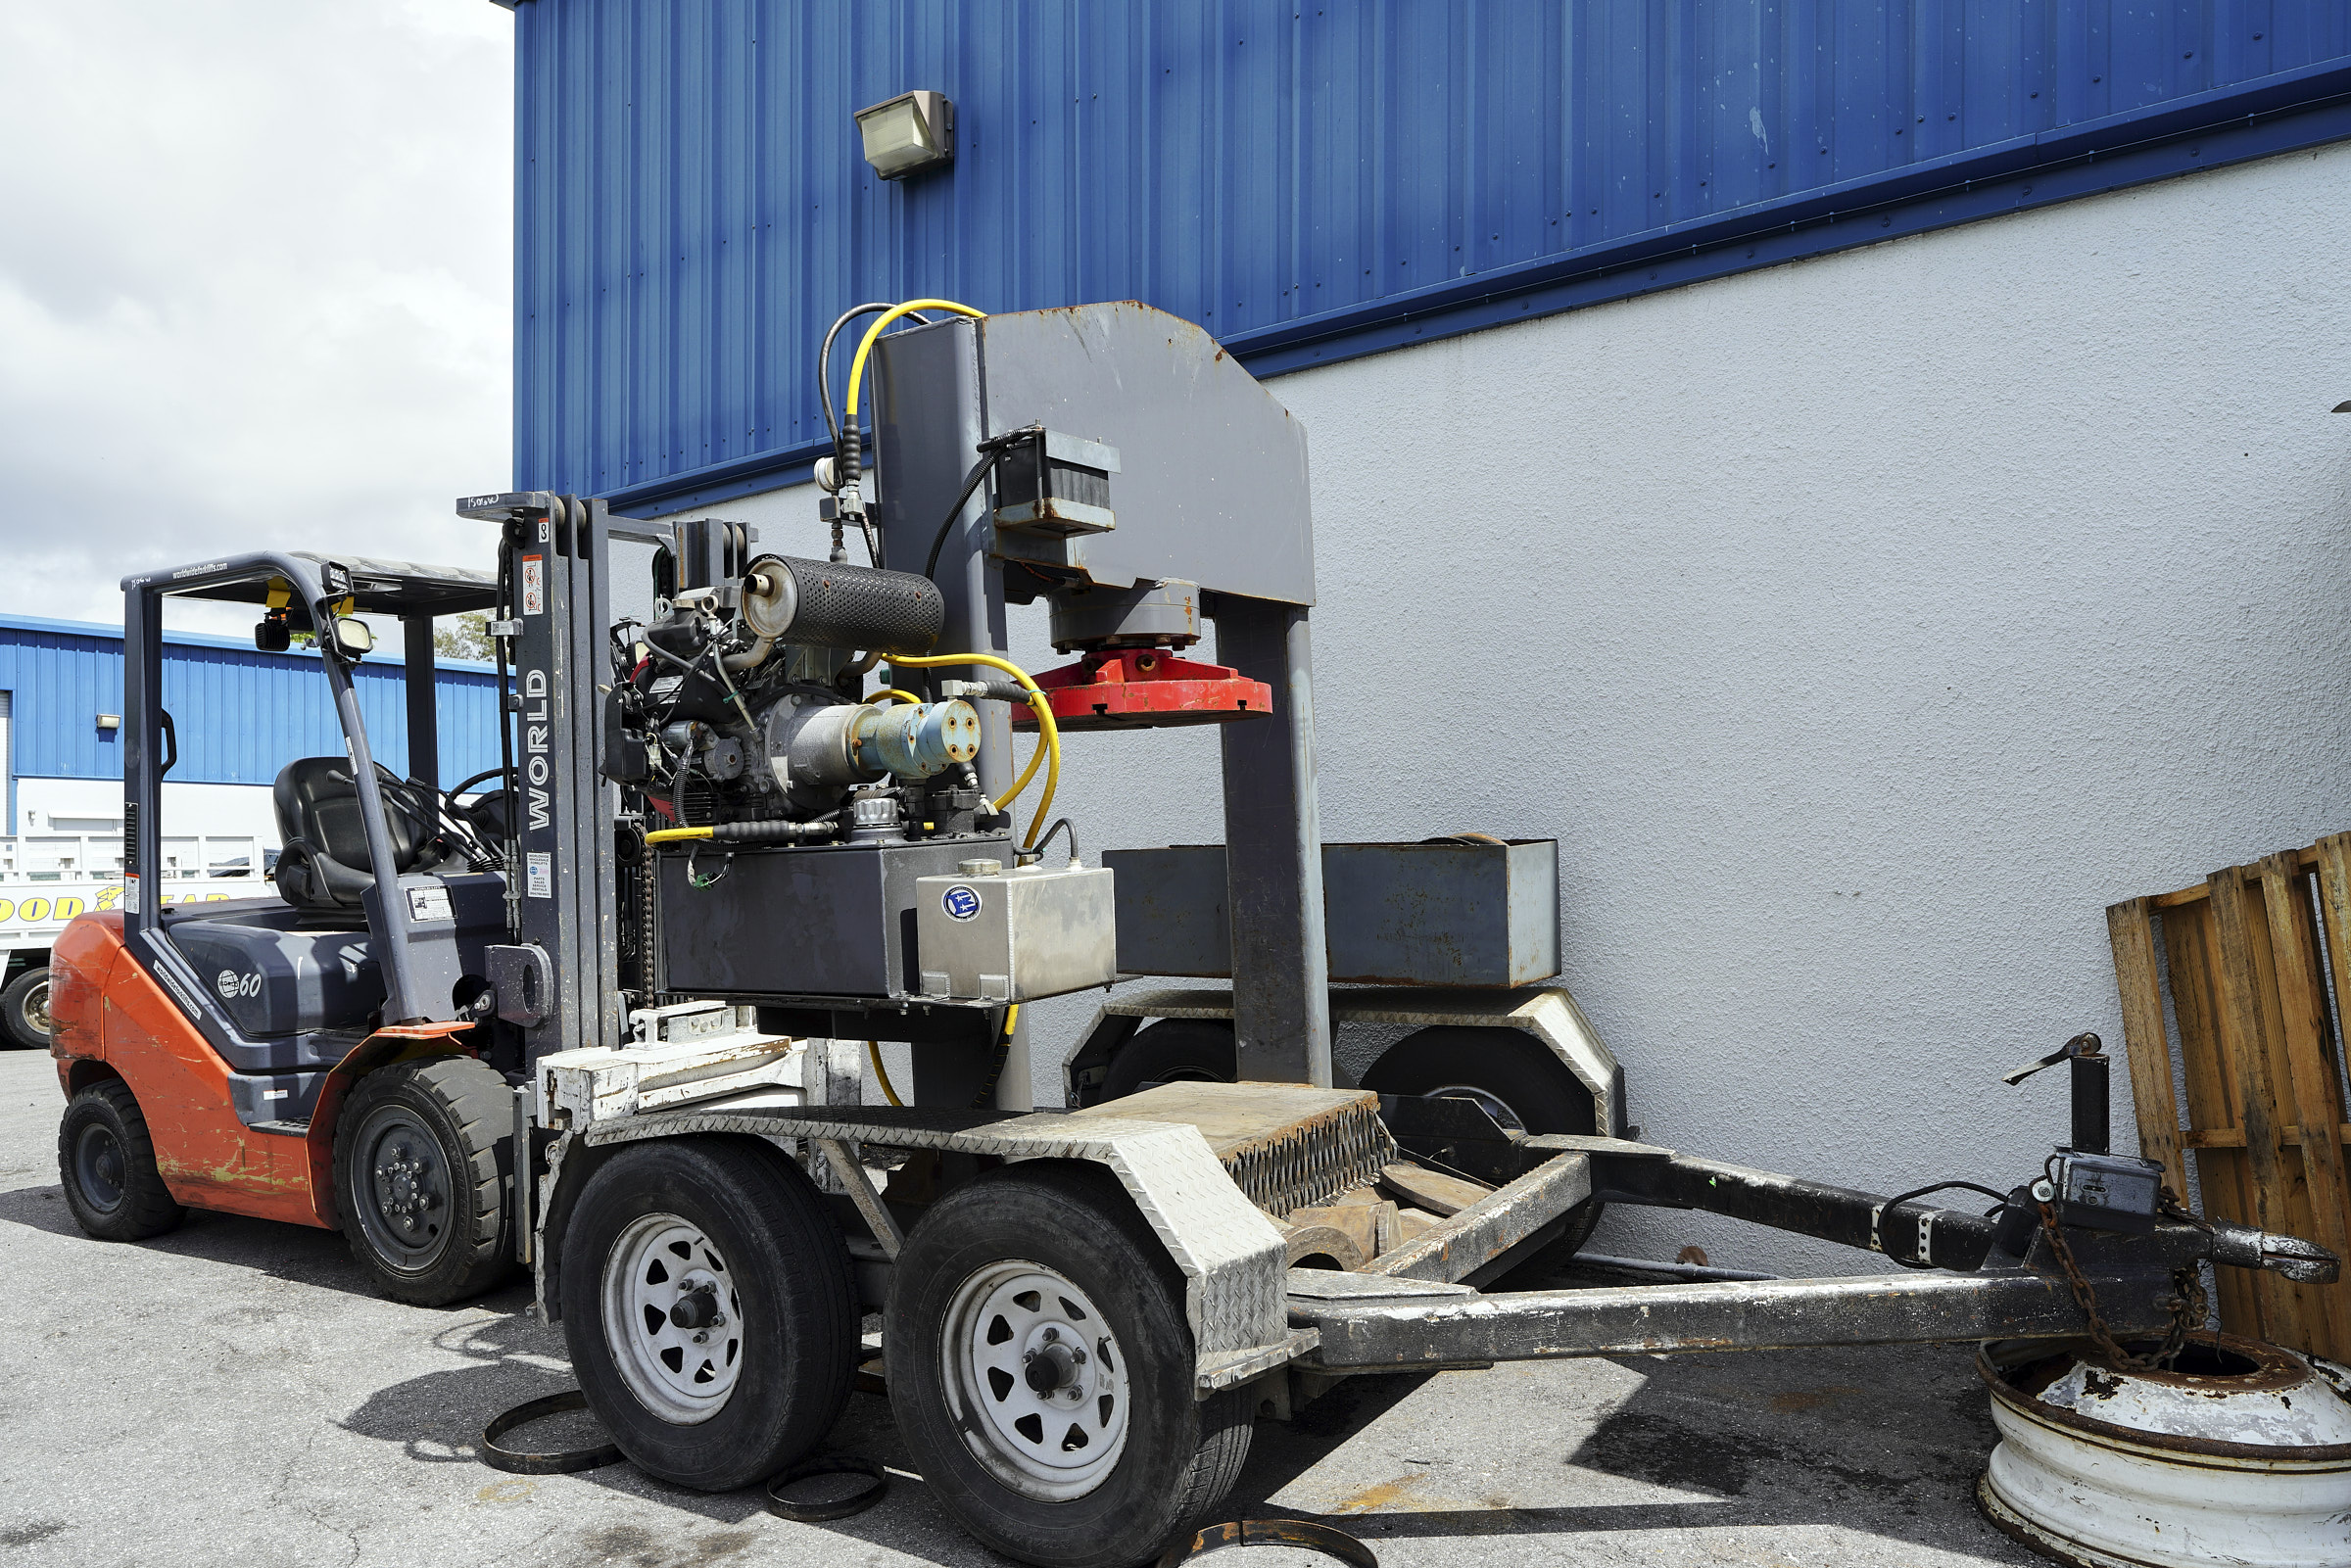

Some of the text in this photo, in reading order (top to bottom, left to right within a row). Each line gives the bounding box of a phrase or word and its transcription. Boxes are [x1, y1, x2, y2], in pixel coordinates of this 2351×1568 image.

[172, 562, 227, 579] worldwideforklifts.com
[526, 669, 550, 831] WORLD
[0, 897, 85, 923] OD
[239, 973, 262, 997] 60
